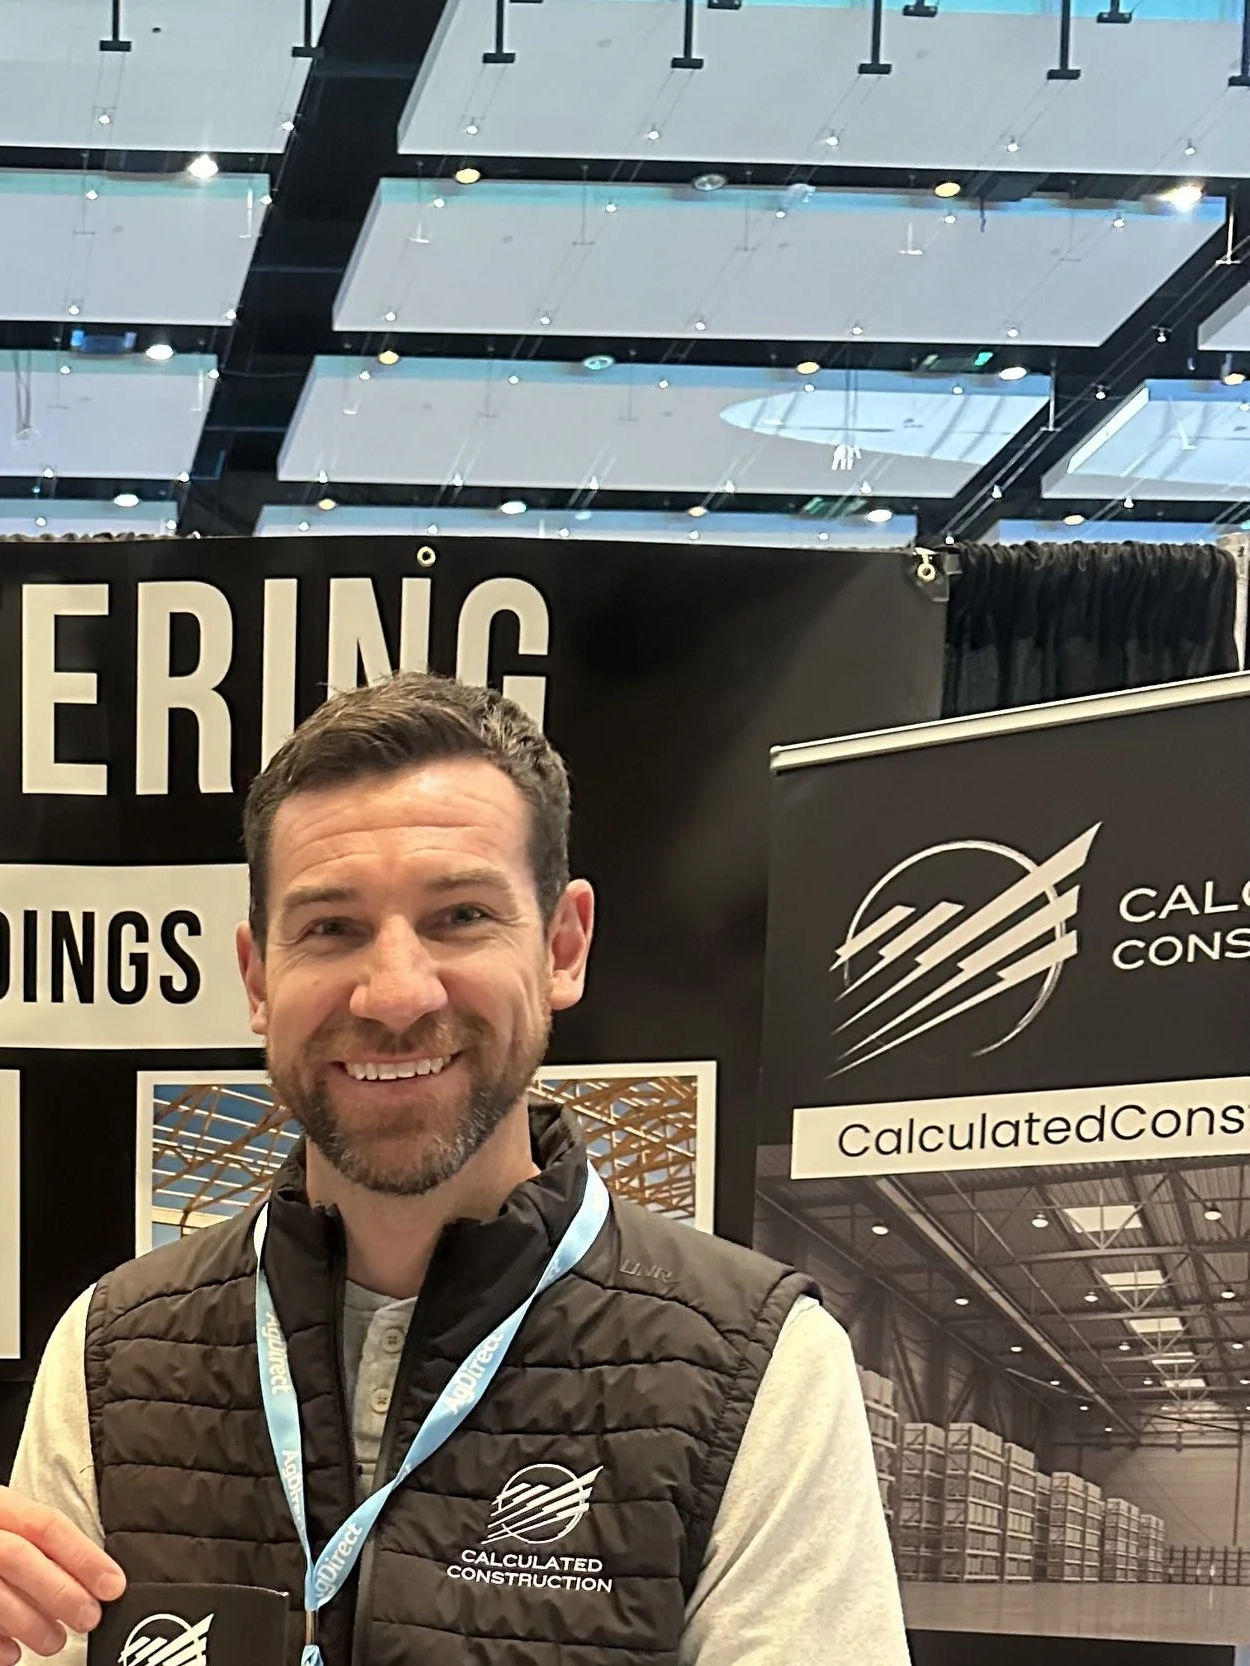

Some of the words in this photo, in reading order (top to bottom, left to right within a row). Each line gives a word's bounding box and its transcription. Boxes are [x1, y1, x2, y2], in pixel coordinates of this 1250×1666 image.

[1119, 881, 1250, 923] CAL
[838, 1104, 1250, 1158] CalculatedCons
[262, 1313, 292, 1394] AgDirect
[443, 1333, 504, 1415] AgDirect
[314, 1523, 362, 1598] gDirect
[447, 1565, 613, 1593] CONSTRUCTION
[461, 1550, 603, 1573] CALCULATED
